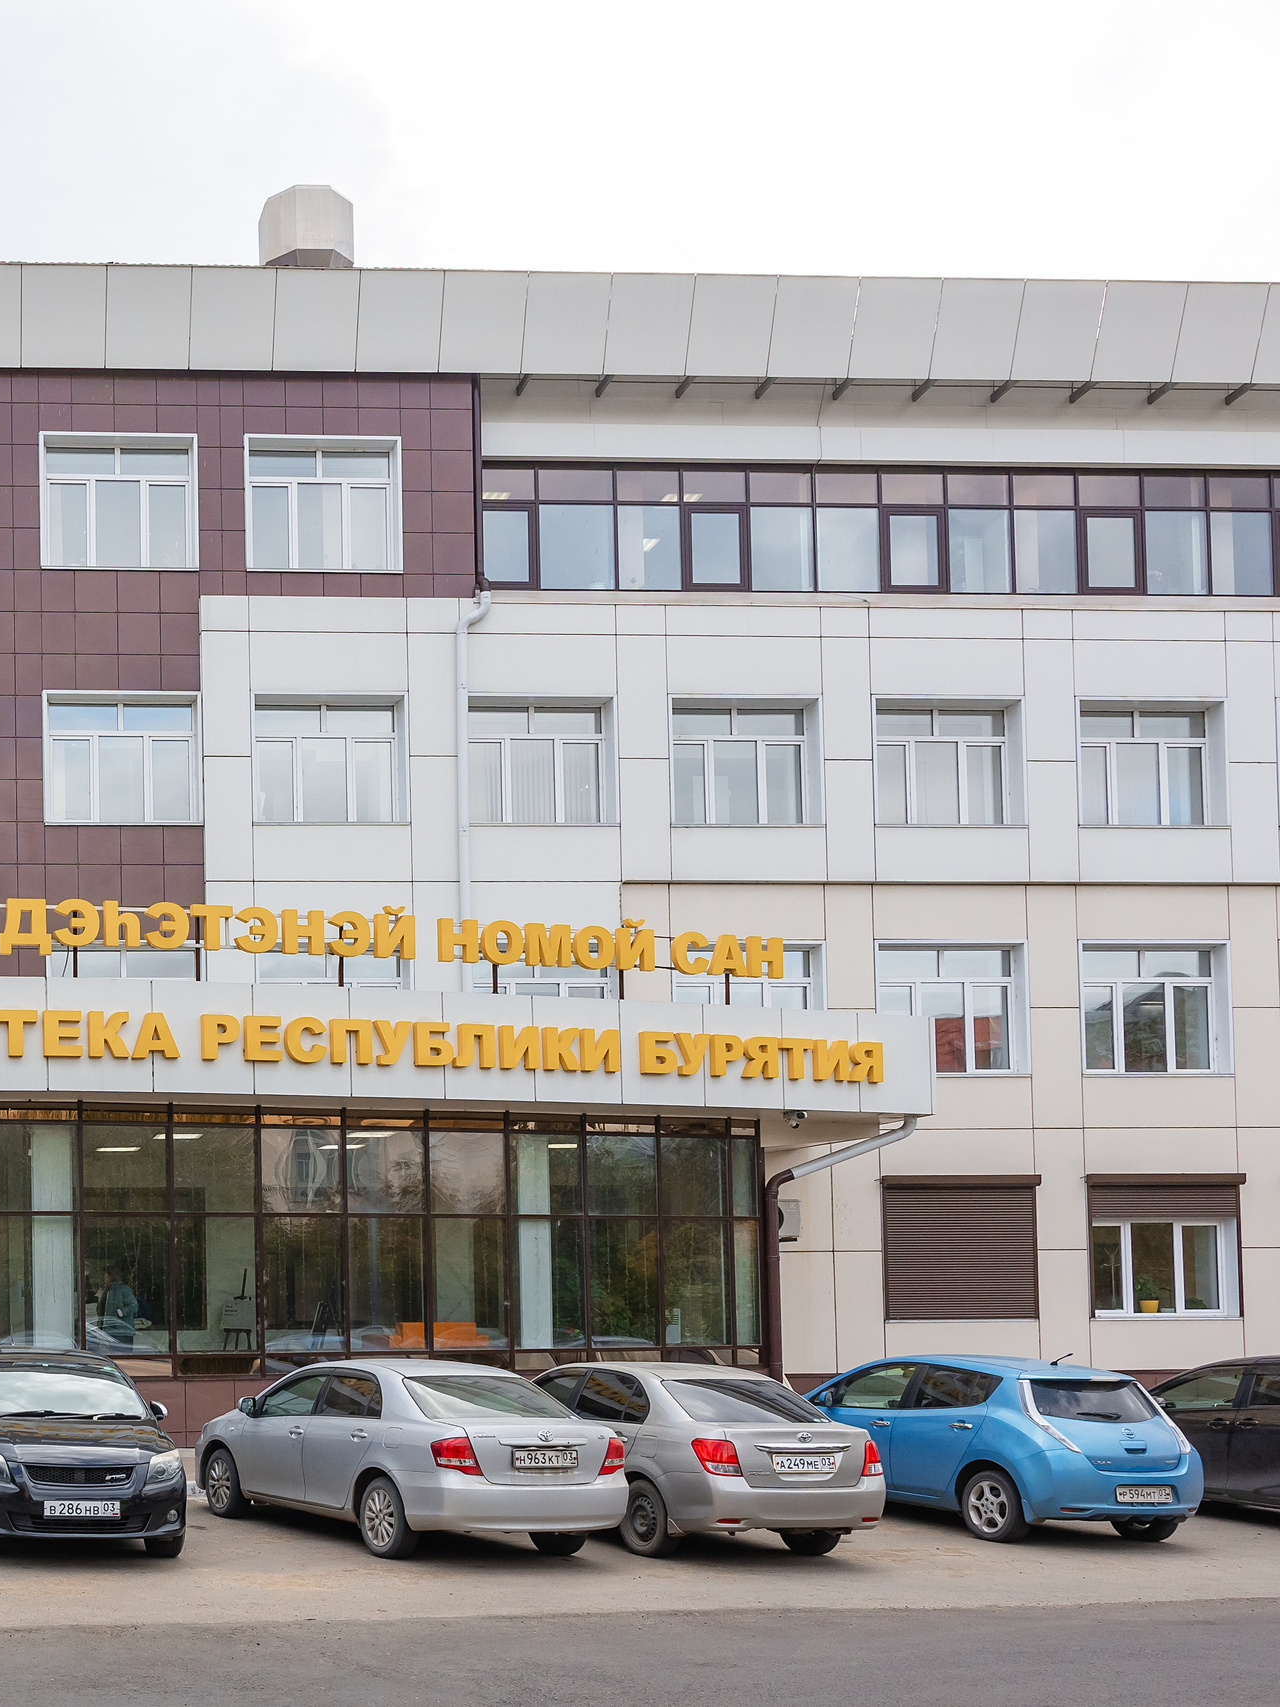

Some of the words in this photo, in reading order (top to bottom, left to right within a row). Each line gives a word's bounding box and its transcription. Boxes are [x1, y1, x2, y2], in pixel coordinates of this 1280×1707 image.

[437, 918, 655, 972] НОМОЙ
[671, 931, 785, 980] САН
[200, 1014, 621, 1073] РЕСПУБЛИКИ
[638, 1031, 885, 1083] БУРЯТИЯ
